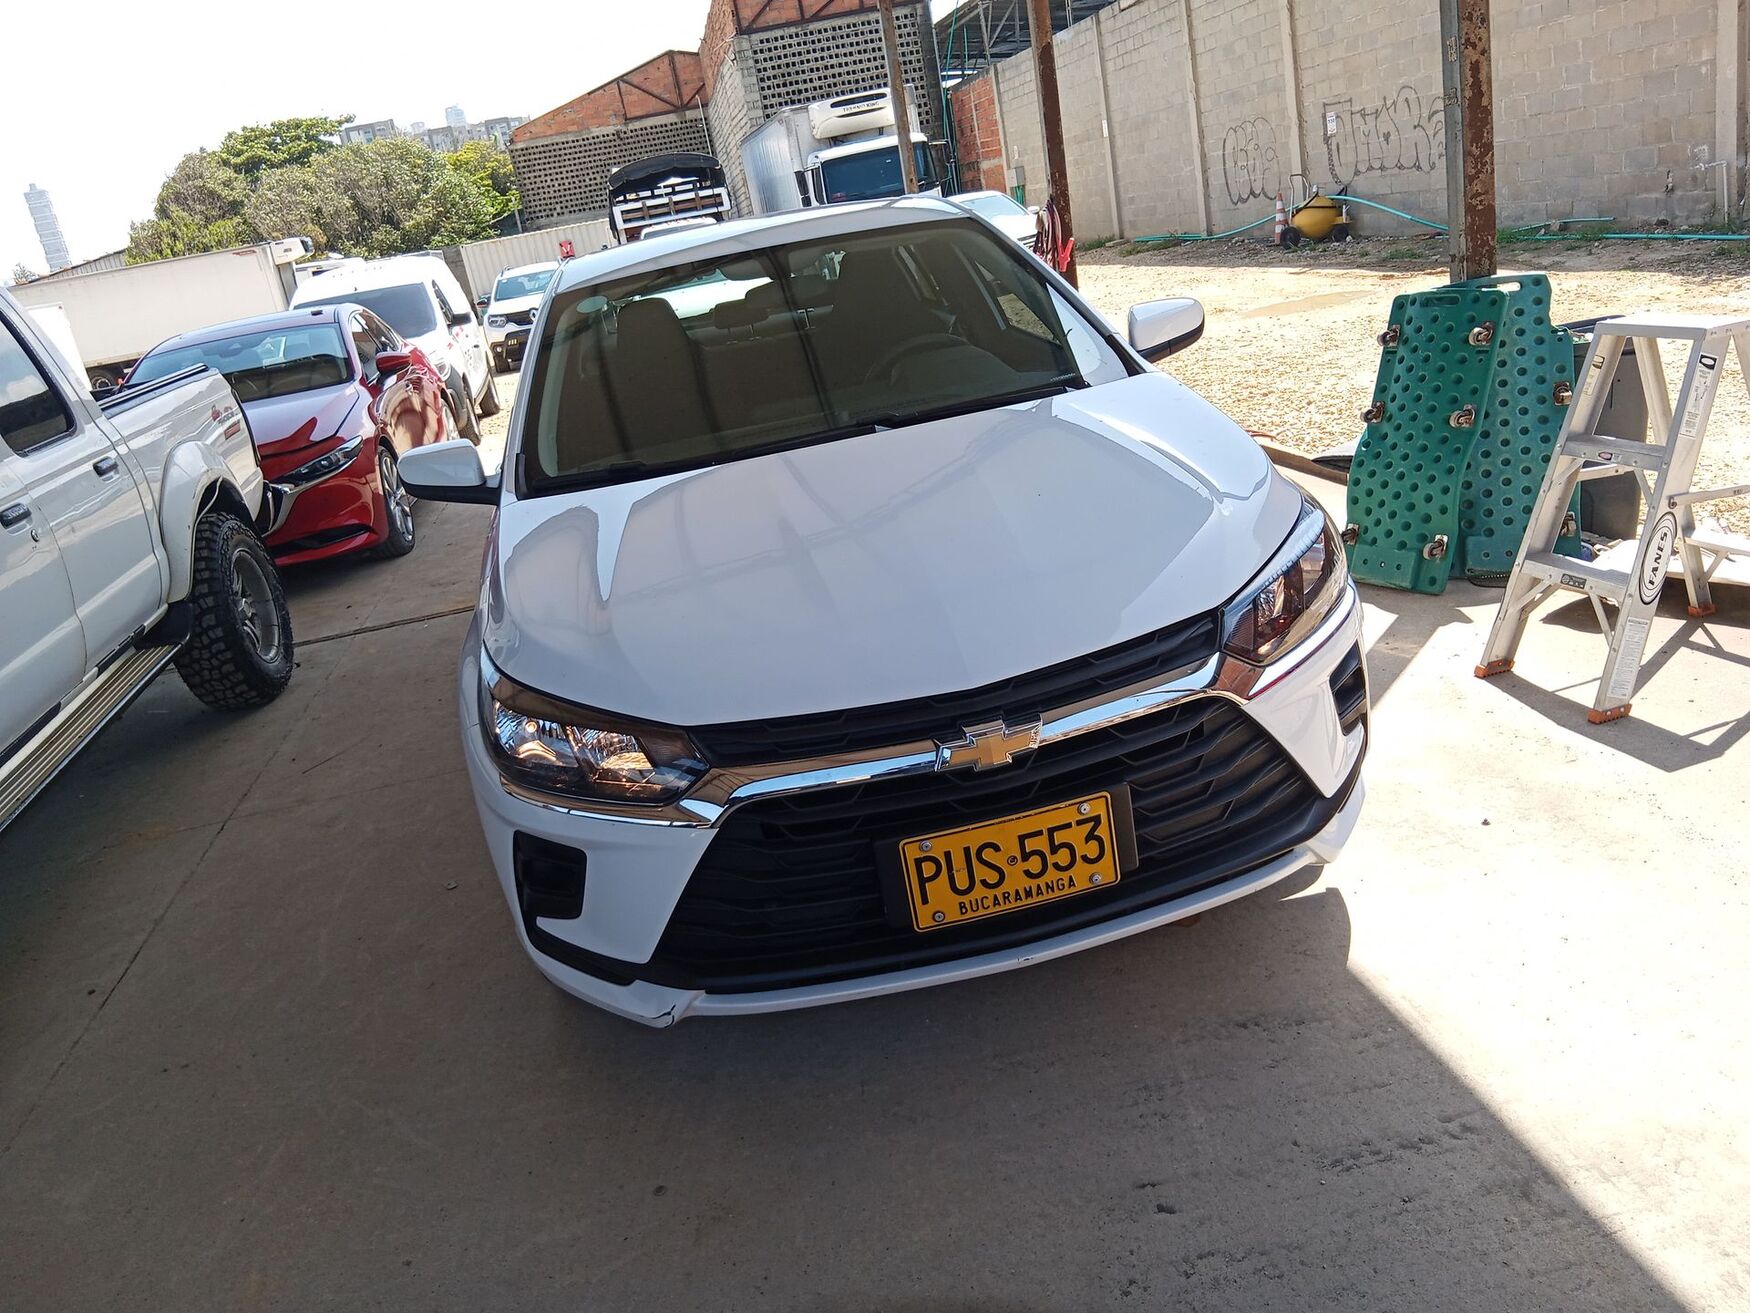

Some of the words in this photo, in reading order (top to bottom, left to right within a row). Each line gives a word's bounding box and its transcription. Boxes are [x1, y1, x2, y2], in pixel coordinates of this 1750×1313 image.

[1648, 531, 1668, 587] FANES
[914, 842, 1006, 905] PUS
[1017, 813, 1106, 880] 553
[959, 875, 1076, 915] BUCARAMANGA
